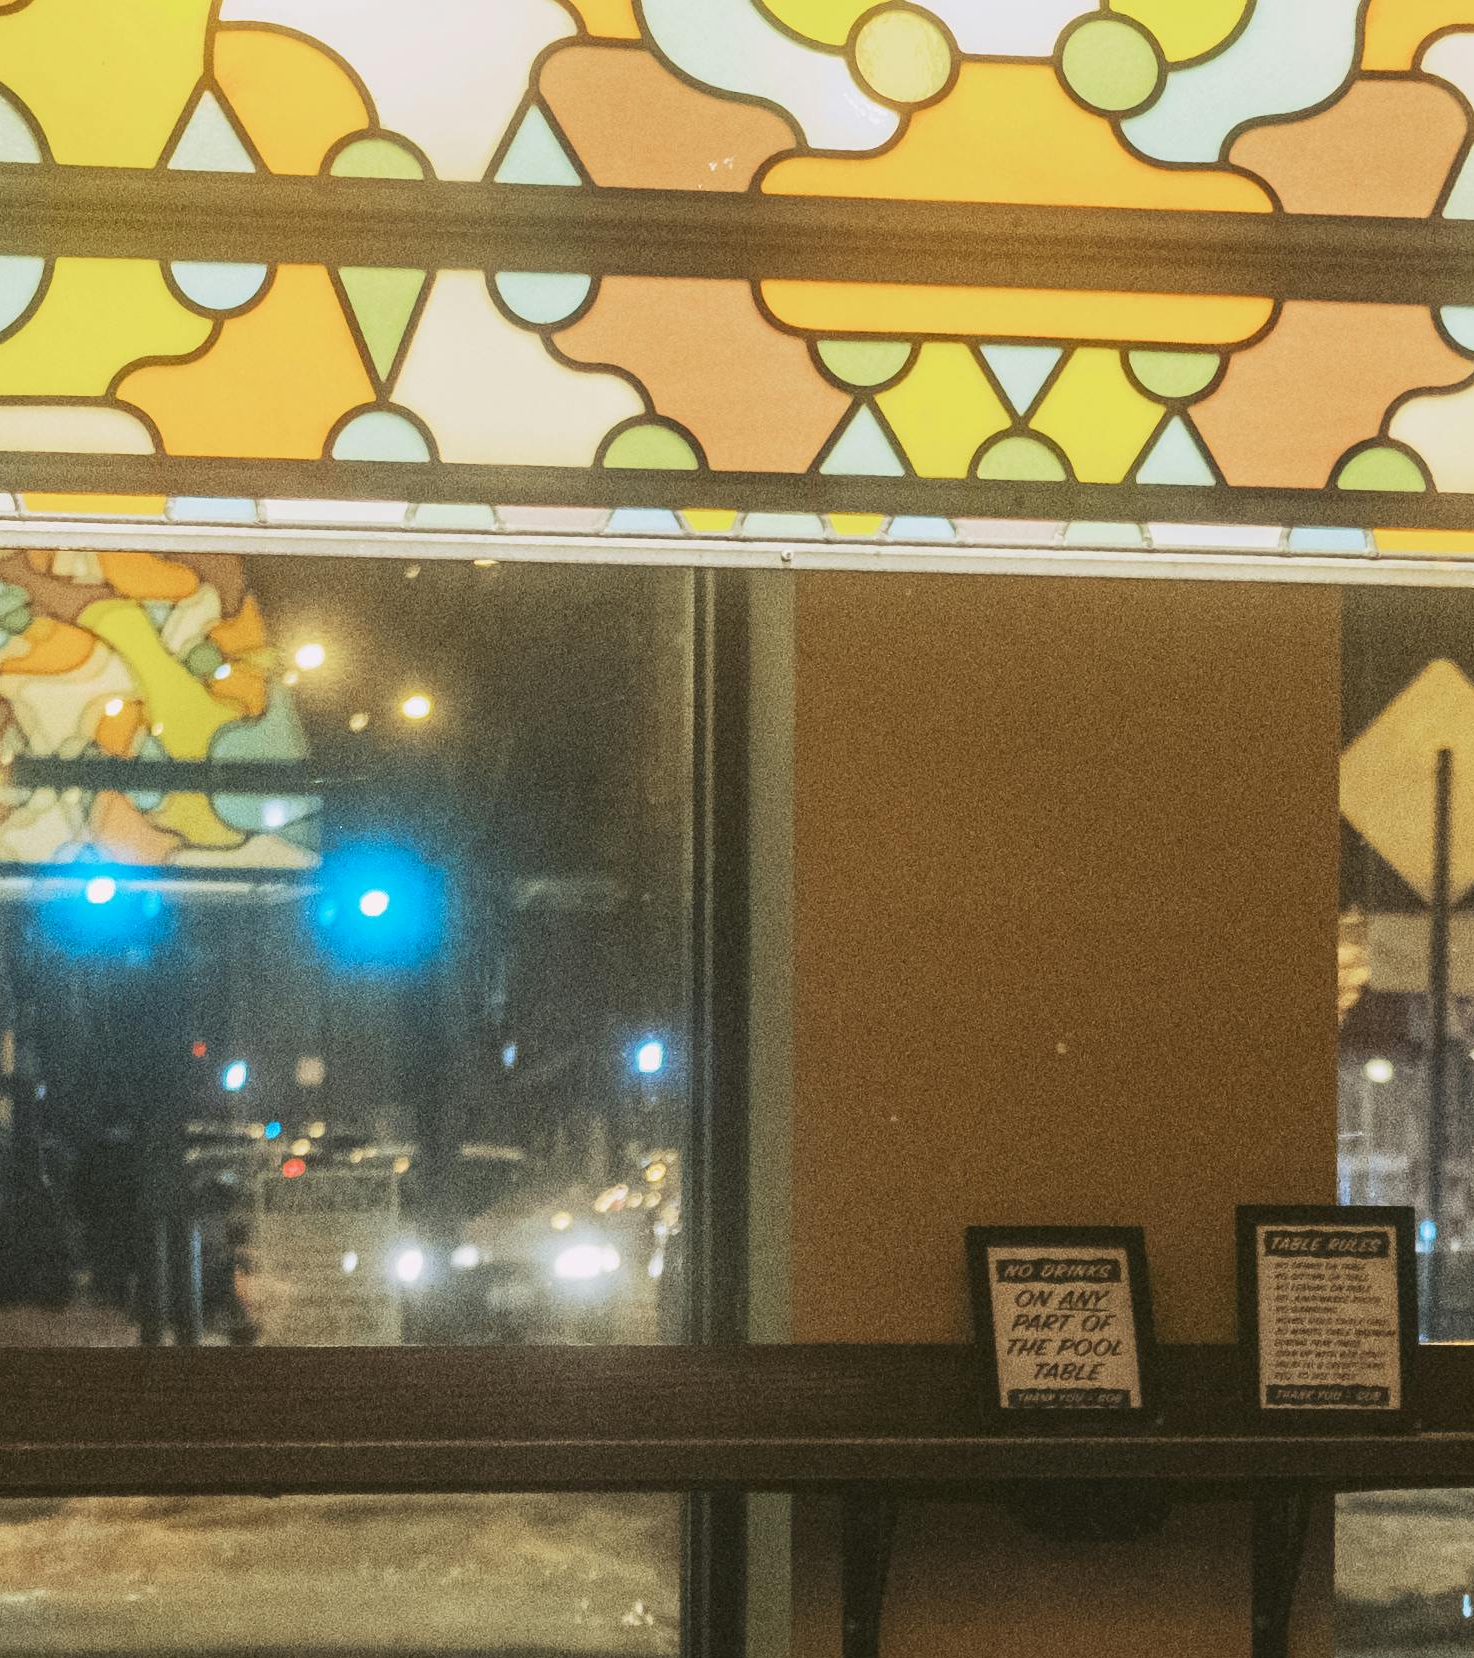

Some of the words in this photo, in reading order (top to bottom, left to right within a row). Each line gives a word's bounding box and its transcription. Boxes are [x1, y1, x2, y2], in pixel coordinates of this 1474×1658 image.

[1270, 1237, 1321, 1251] TABLE
[1327, 1237, 1382, 1252] RULES
[1004, 1264, 1033, 1278] NO
[1040, 1264, 1112, 1278] DRINKS
[1013, 1290, 1053, 1308] ON
[1057, 1290, 1110, 1311] ANY
[1011, 1314, 1075, 1332] PART
[1081, 1314, 1116, 1332] OF
[1005, 1338, 1052, 1356] THE
[1055, 1337, 1124, 1357] POOL
[1032, 1362, 1106, 1381] TABLE
